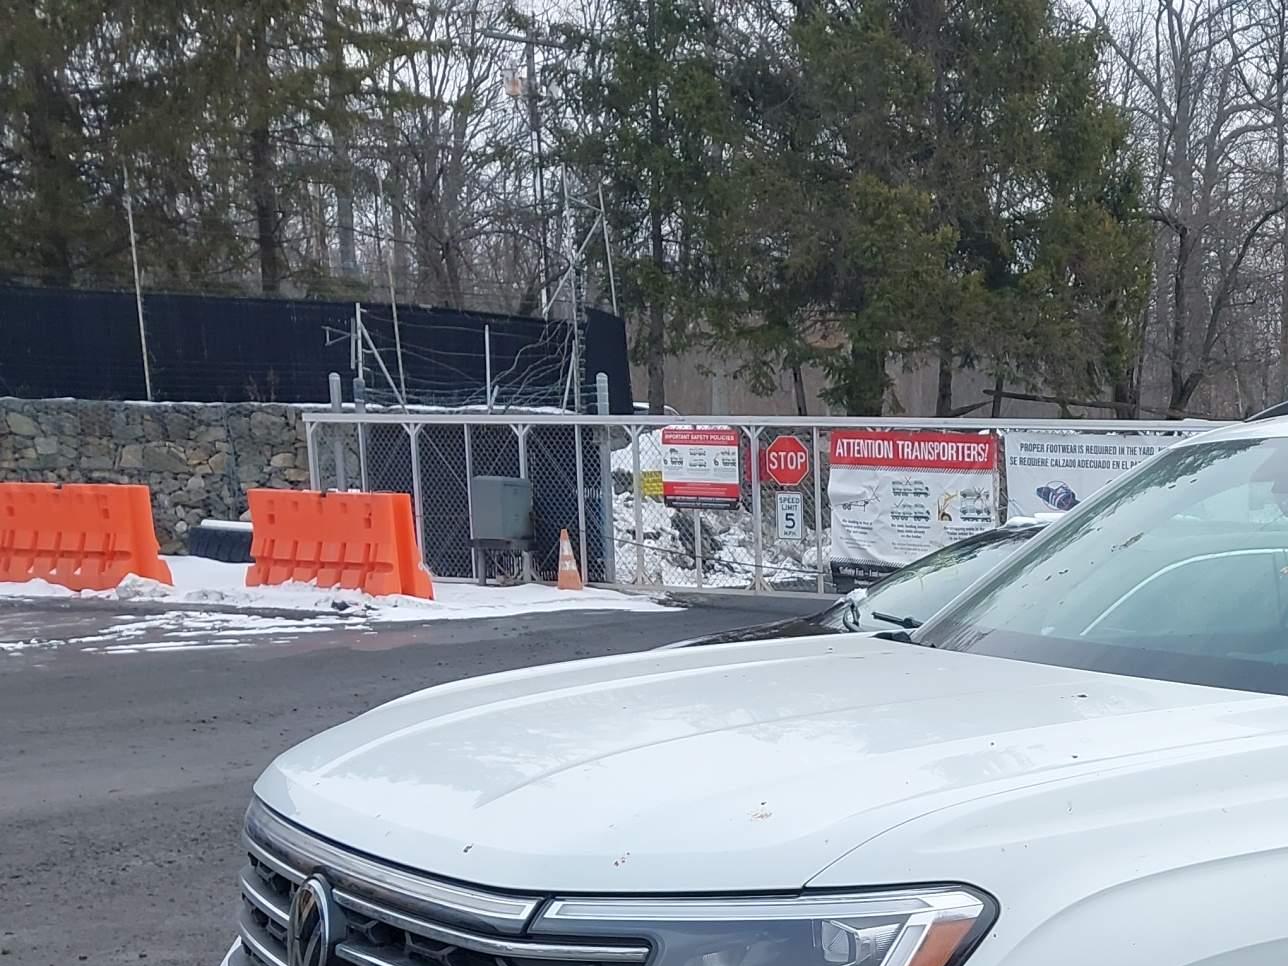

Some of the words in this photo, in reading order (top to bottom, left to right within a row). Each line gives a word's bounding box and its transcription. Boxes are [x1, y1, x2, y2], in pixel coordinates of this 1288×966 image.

[836, 438, 893, 459] ATTENTION
[897, 440, 988, 462] TRANSPORTERS!
[1020, 442, 1044, 452] PROPER
[1046, 444, 1077, 453] FOOTWEAR
[1078, 445, 1084, 454] IS
[1086, 445, 1116, 454] REQUIRED
[1118, 446, 1124, 455] IN
[1126, 446, 1137, 455] THE
[1138, 446, 1154, 455] YARD
[769, 452, 806, 470] STOP
[1010, 456, 1017, 465] SE
[1019, 457, 1048, 466] REQUIERE
[1050, 458, 1076, 468] CALZADO
[1077, 459, 1110, 468] ADECUADO
[1112, 461, 1120, 469] EN
[1122, 461, 1129, 469] EL
[785, 512, 796, 529] 5
